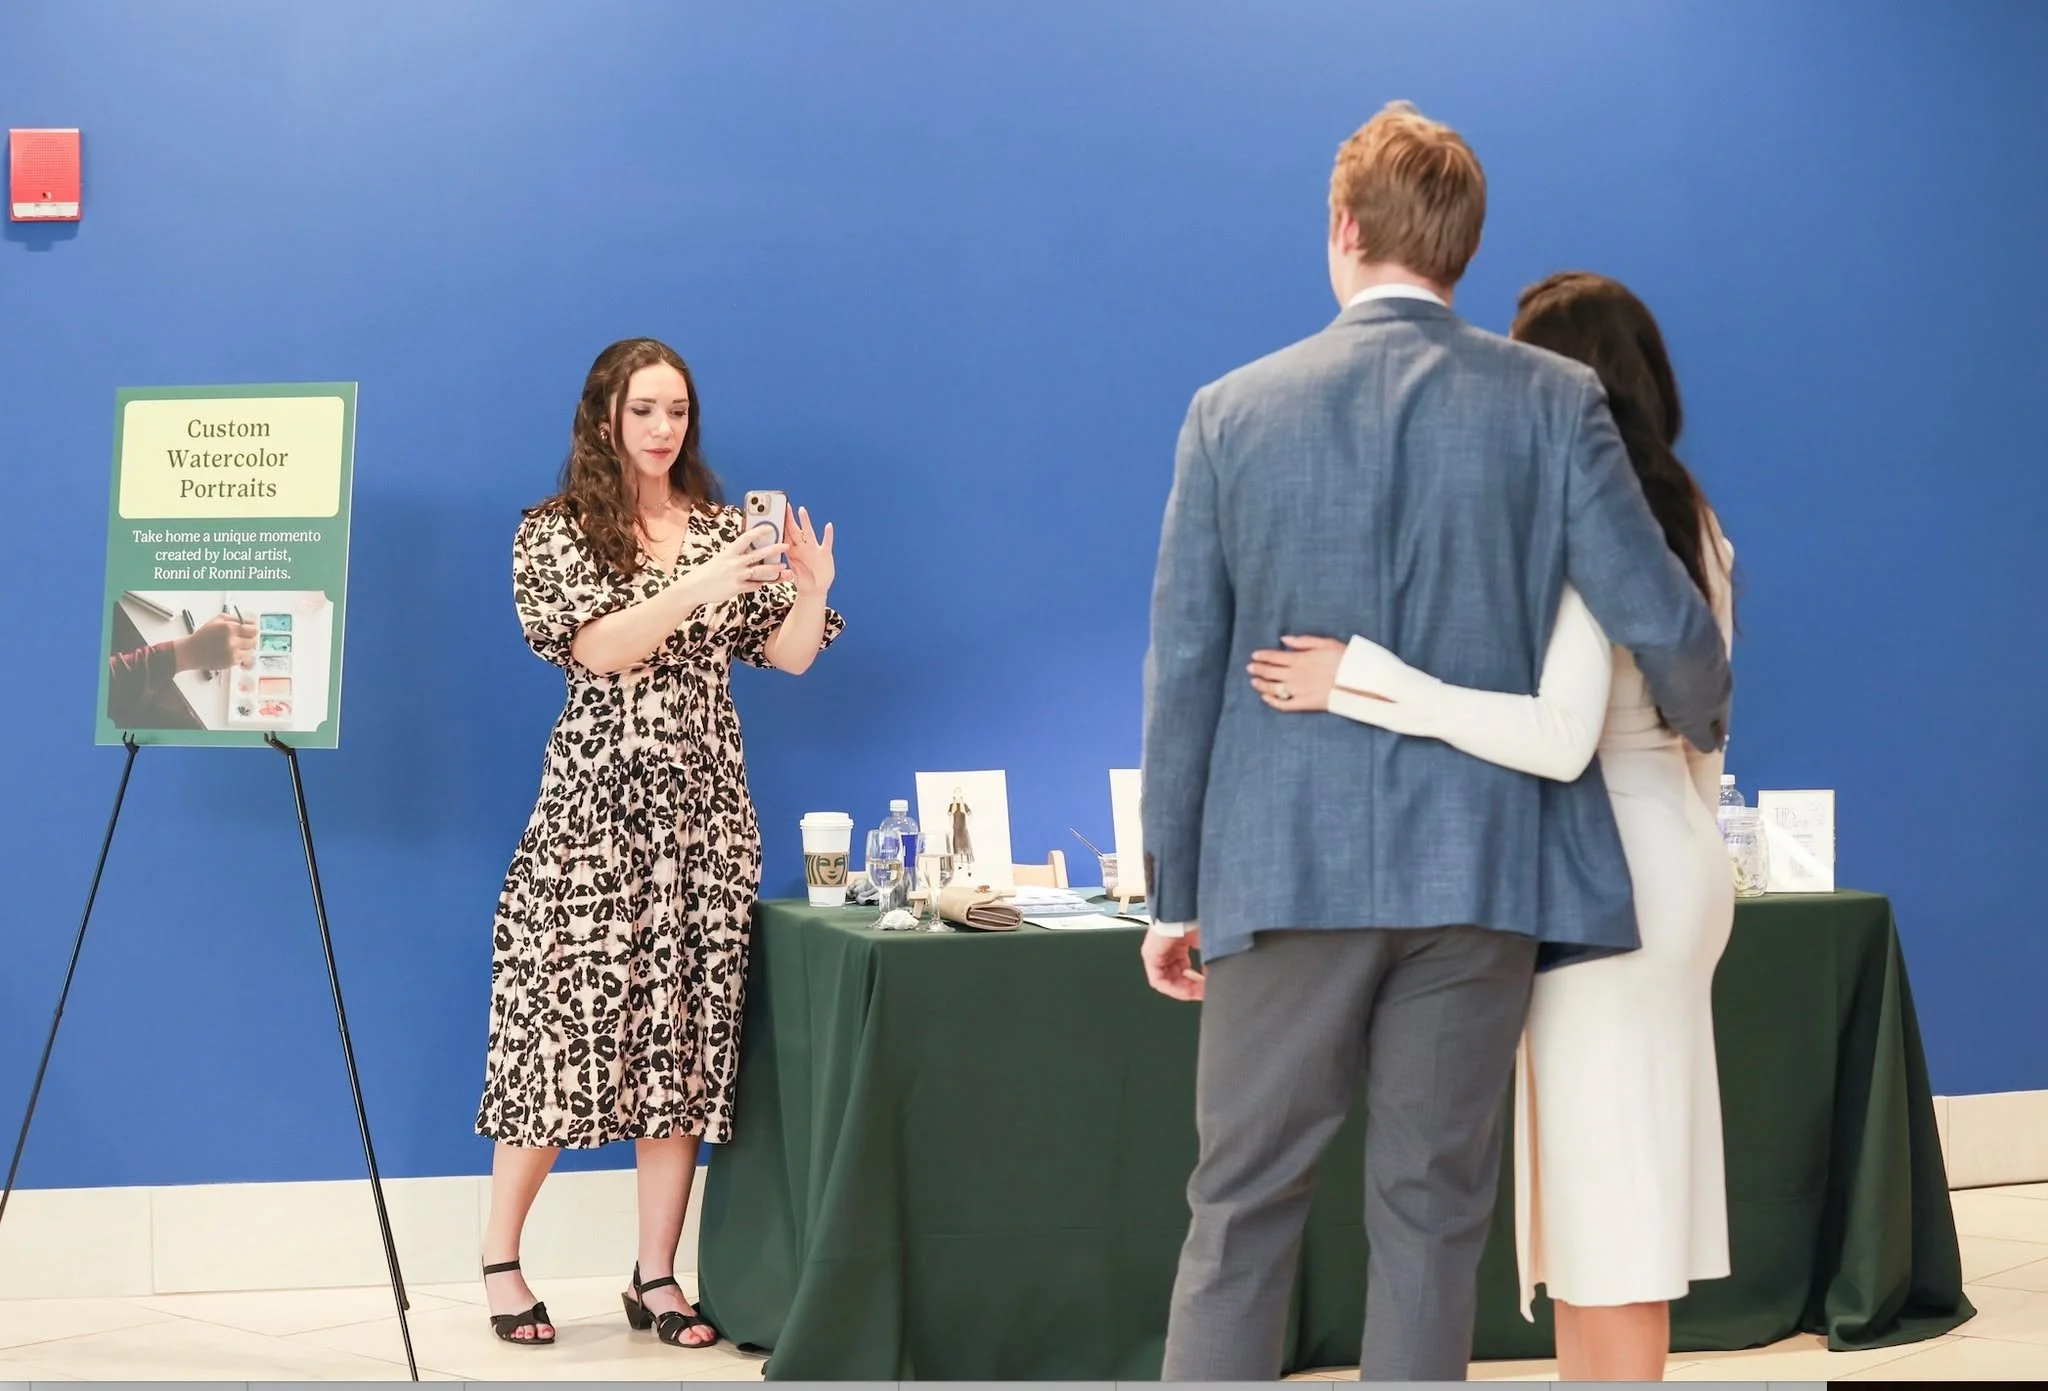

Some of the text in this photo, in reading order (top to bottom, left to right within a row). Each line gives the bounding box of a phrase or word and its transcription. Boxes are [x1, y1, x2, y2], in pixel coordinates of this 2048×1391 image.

[187, 419, 270, 439] Custom
[167, 448, 289, 468] Watercolor
[180, 478, 277, 498] Portraits
[133, 529, 321, 545] Take home a unique momento
[155, 548, 291, 564] created by local artist,
[154, 567, 291, 580] Ronni of Ronni Paints.
